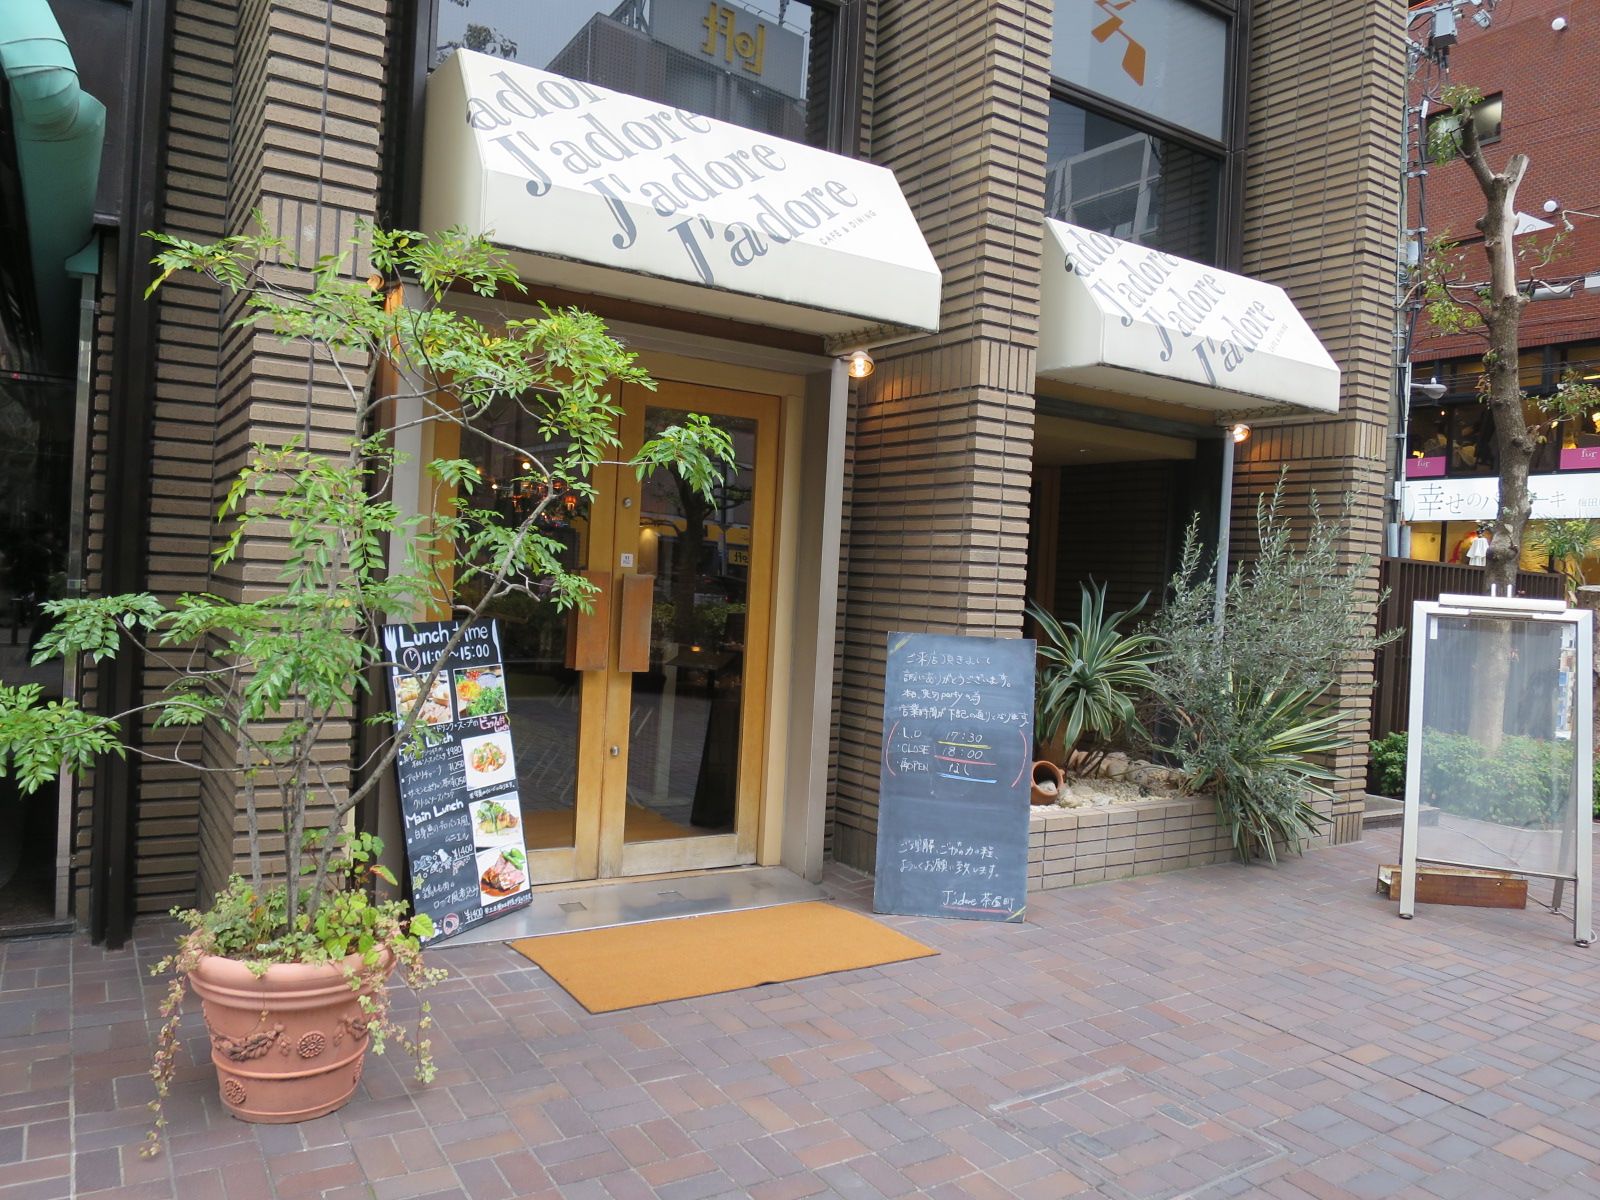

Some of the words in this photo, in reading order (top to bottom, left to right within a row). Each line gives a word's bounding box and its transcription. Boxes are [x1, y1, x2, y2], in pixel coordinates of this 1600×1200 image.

[489, 106, 712, 198] J'adore
[585, 139, 789, 250] J'adore
[668, 177, 859, 285] J'adore
[1091, 249, 1180, 327] J'adore
[1142, 271, 1227, 362] J'adore
[1191, 299, 1276, 387] J'adore
[399, 622, 449, 648] Lunch
[942, 747, 983, 760] 18:00
[946, 731, 983, 743] 17:30
[405, 810, 431, 829] Main
[433, 800, 464, 818] Lunch
